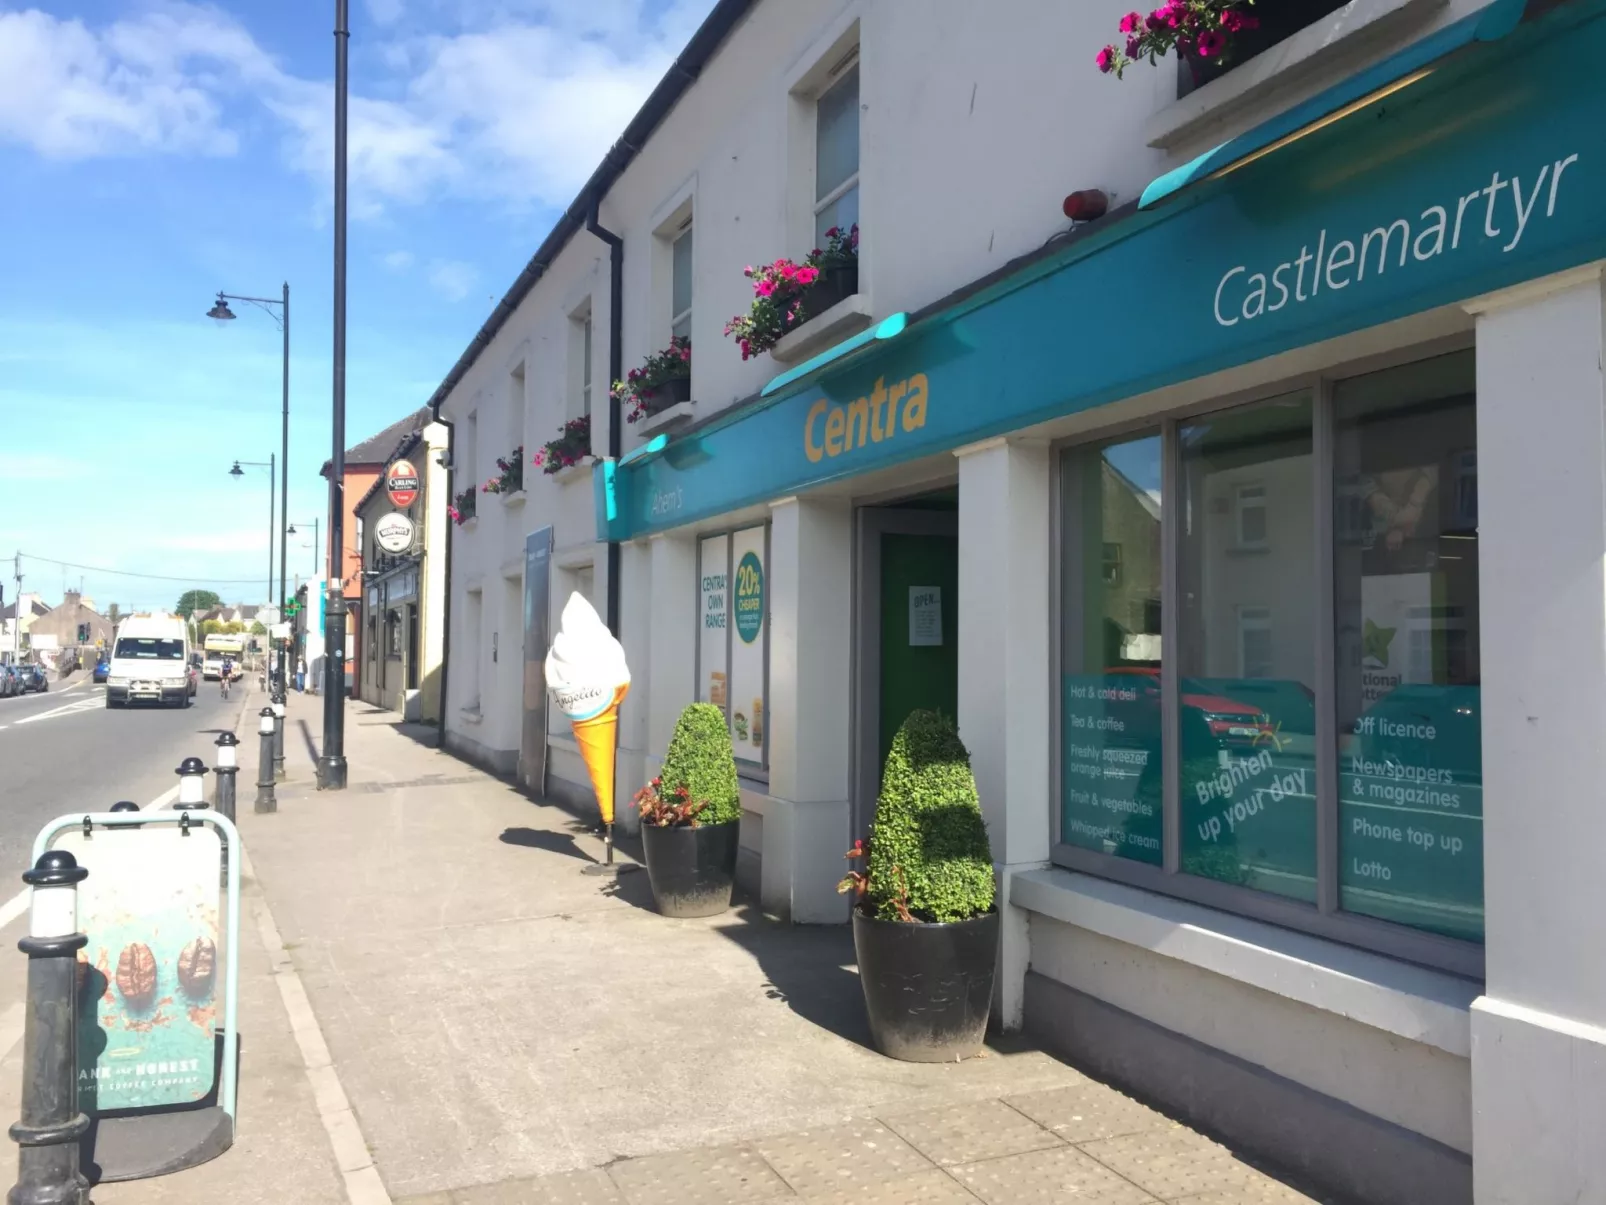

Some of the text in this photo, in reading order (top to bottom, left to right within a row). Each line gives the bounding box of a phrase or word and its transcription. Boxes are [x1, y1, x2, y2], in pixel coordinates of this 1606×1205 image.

[1214, 153, 1578, 326] Castlemartyr
[804, 372, 929, 463] Centra
[389, 478, 417, 487] CARLING
[739, 565, 761, 596] 20%
[708, 595, 724, 610] OWN
[739, 598, 760, 611] CHEAPER
[705, 613, 726, 629] RANGE
[1362, 673, 1402, 686] tional
[1070, 686, 1137, 701] Hot & cold deli
[1070, 714, 1125, 732] Tea & coffee
[1353, 716, 1437, 740] Off licence
[1070, 744, 1148, 768] Freshly squeezed
[1070, 763, 1101, 780] orange
[1195, 749, 1273, 805] Brighten
[1352, 756, 1453, 785] Newspapers
[1070, 789, 1153, 817] Fruit & vegetables
[1198, 768, 1308, 842] up your day
[1352, 777, 1461, 809] & magazines
[1070, 819, 1160, 850] Whipped ice cream
[1352, 817, 1463, 855] Phone top up
[1353, 857, 1392, 881] Lotto
[78, 1067, 112, 1080] ANK
[136, 1059, 199, 1076] HONEST
[151, 1076, 199, 1087] COMPANY
